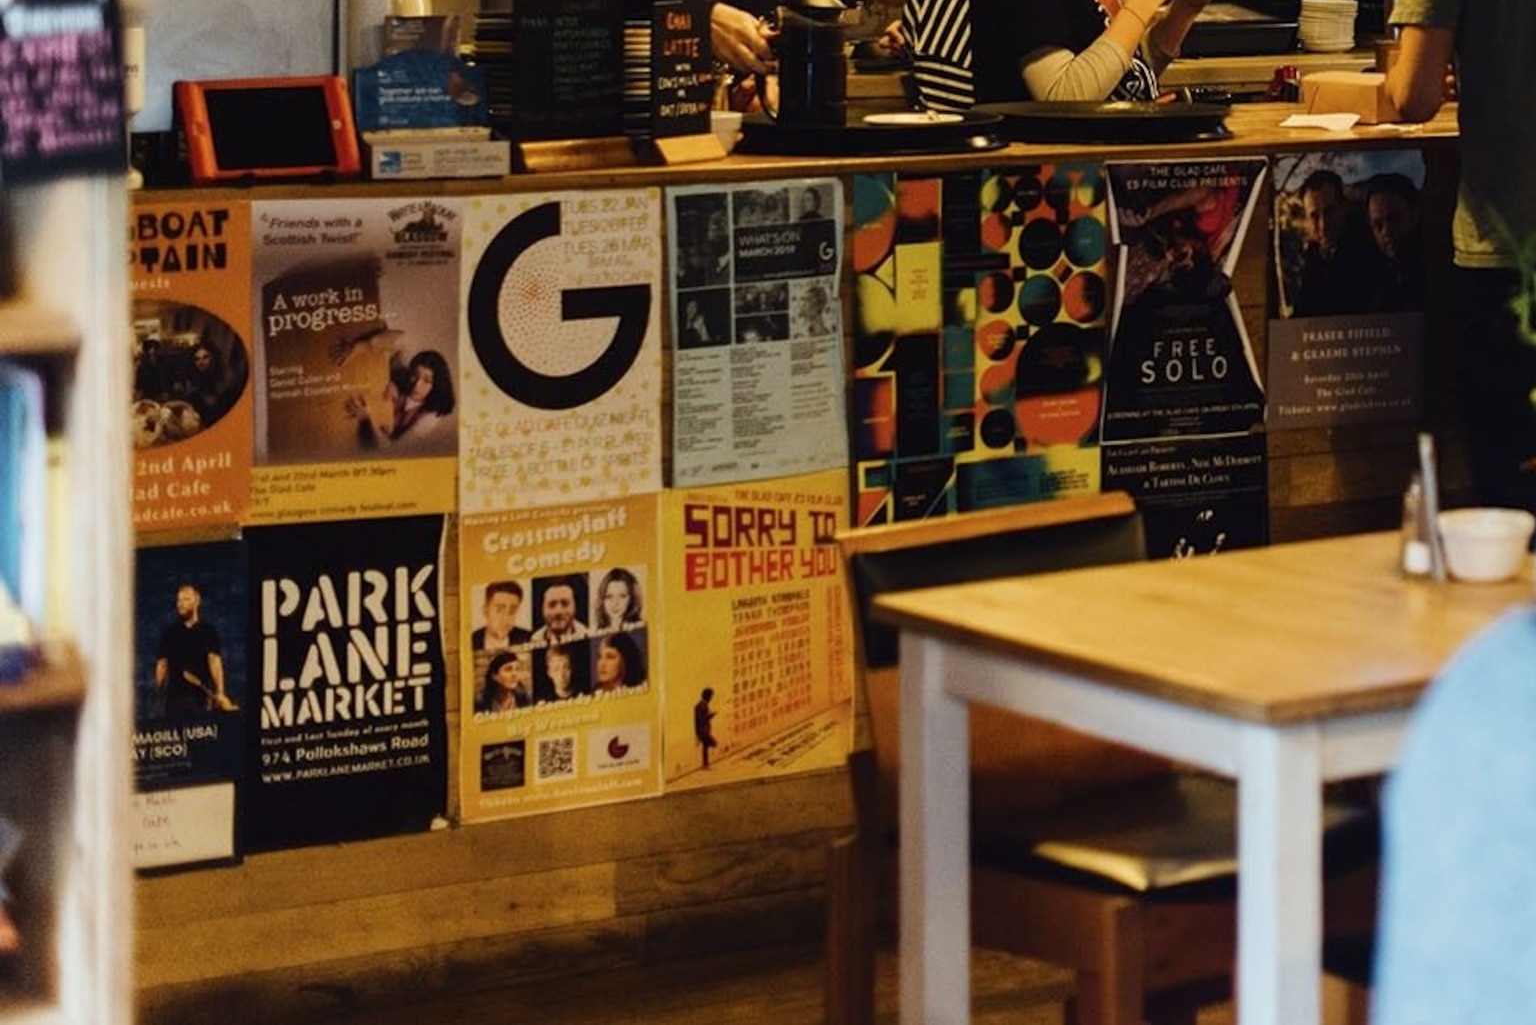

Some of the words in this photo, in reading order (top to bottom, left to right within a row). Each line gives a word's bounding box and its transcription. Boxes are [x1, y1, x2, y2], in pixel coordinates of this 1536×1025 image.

[666, 12, 692, 31] CHAI
[664, 36, 700, 58] LATTE
[130, 209, 229, 241] BOAT
[819, 241, 835, 262] G
[273, 293, 288, 311] A
[292, 287, 340, 308] work
[344, 286, 364, 303] in
[468, 201, 652, 411] G
[1153, 338, 1217, 359] FREE
[1302, 329, 1345, 343] FRASER
[1303, 346, 1349, 361] GRAEME
[1352, 344, 1402, 357] STEPHEN
[1140, 355, 1229, 384] SOLO
[137, 457, 174, 476] 2nd
[181, 451, 231, 476] April
[166, 479, 211, 498] Cafe
[483, 505, 628, 554] Crossmylaff
[685, 503, 797, 549] SORRY
[809, 509, 836, 545] TO
[506, 541, 607, 574] Comedy
[685, 548, 794, 592] BOTHER
[800, 547, 837, 579] YOU
[262, 564, 436, 636] PARK
[263, 620, 432, 693] LANE
[261, 676, 432, 730] MARKET
[182, 723, 218, 740] (USA)
[149, 742, 188, 760] (SCO)
[262, 750, 292, 766] 974
[295, 740, 388, 762] Pollokshaws
[391, 733, 430, 750] Road
